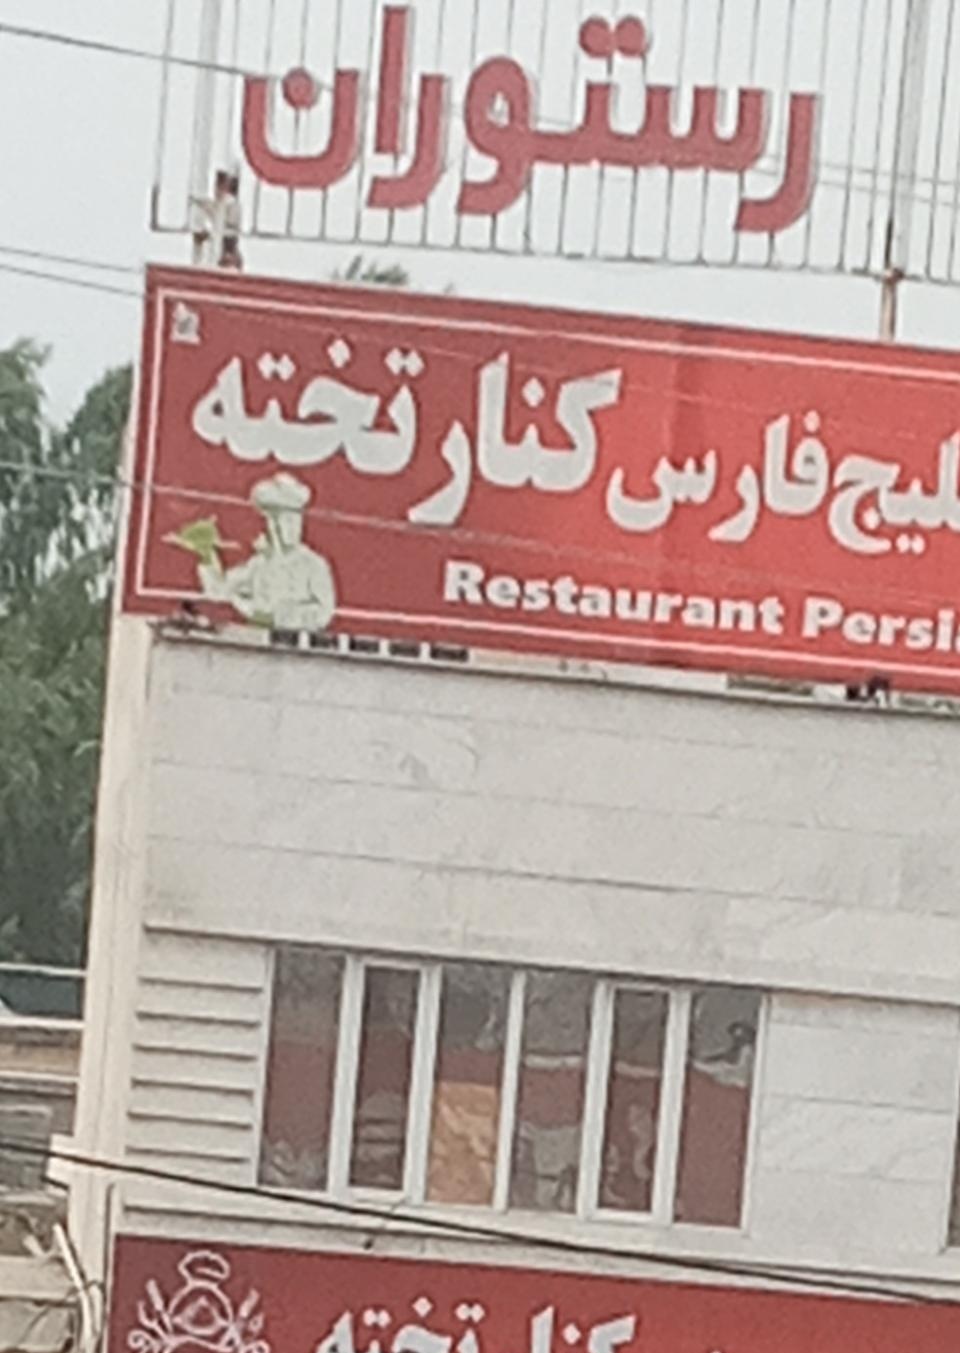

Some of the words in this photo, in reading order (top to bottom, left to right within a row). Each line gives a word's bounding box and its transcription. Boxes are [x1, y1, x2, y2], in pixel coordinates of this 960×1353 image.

[241, 5, 818, 233] رستوران
[606, 410, 829, 542] فارس
[443, 560, 785, 635] Restaurant
